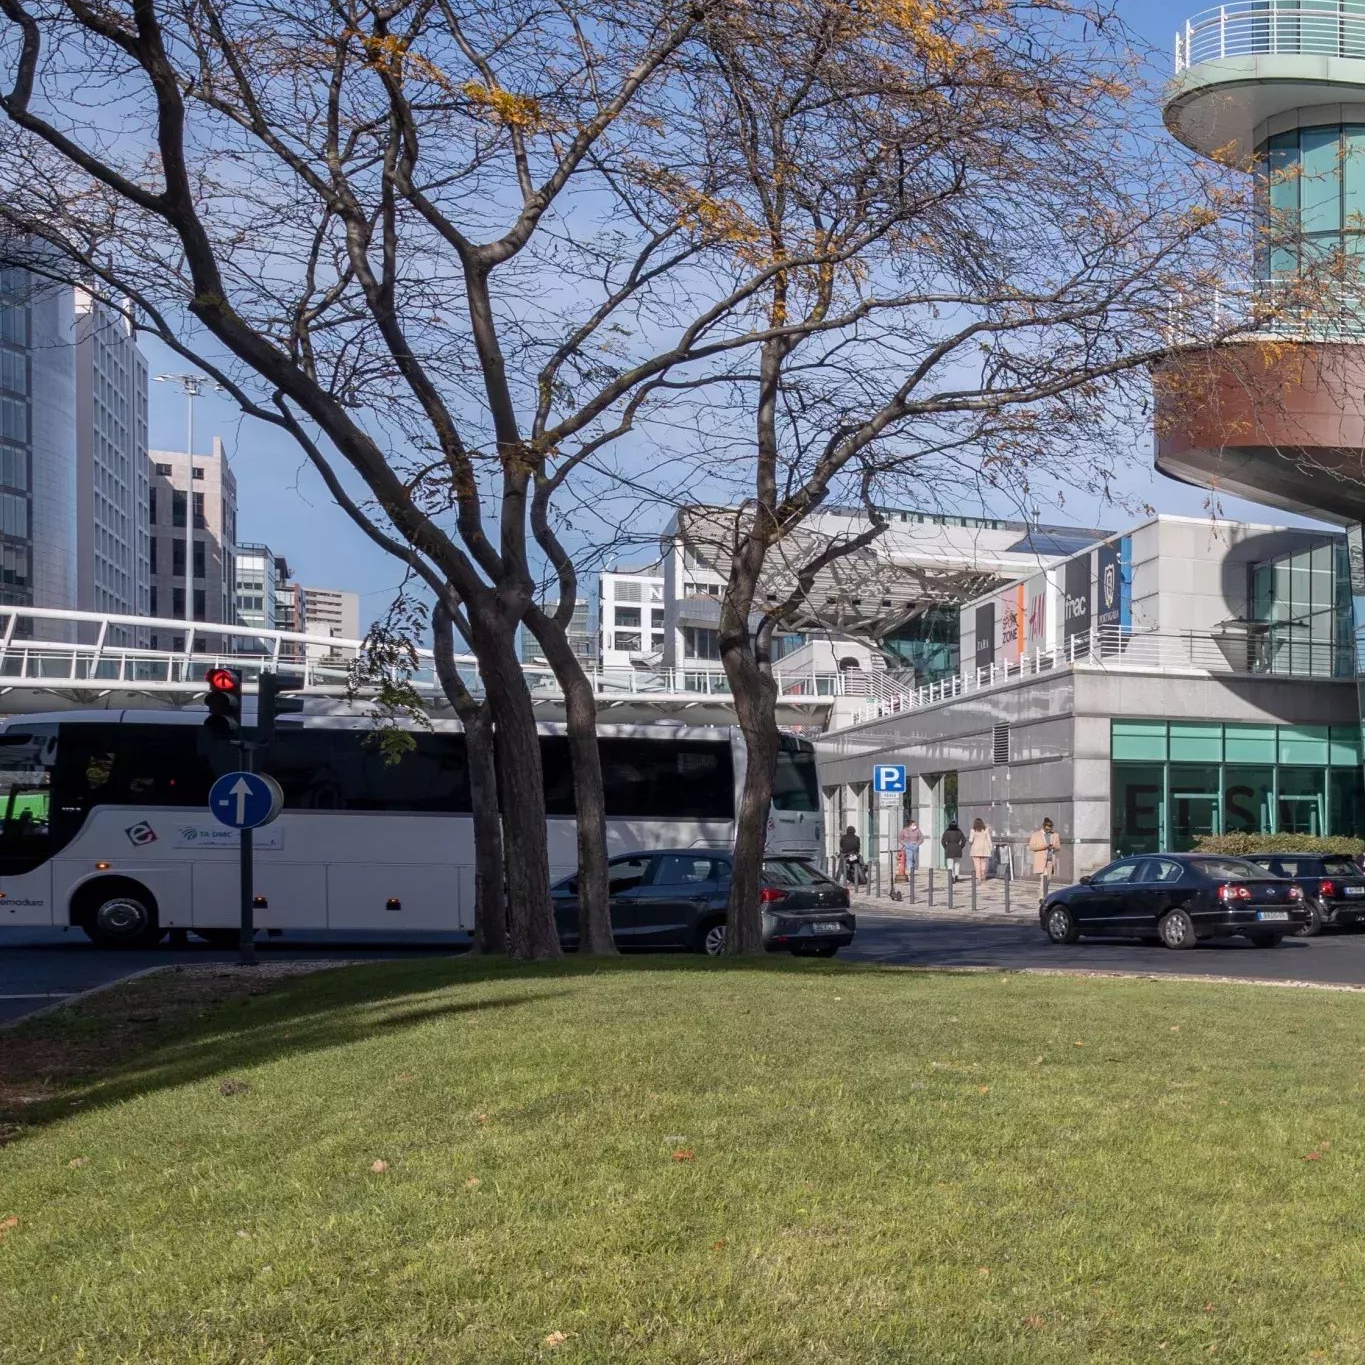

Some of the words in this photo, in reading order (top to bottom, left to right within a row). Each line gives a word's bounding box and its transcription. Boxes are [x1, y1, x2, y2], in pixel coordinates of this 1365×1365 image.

[1065, 594, 1086, 620] fnac
[977, 639, 989, 651] ZARA
[1003, 628, 1018, 644] ZONE
[880, 767, 900, 790] P
